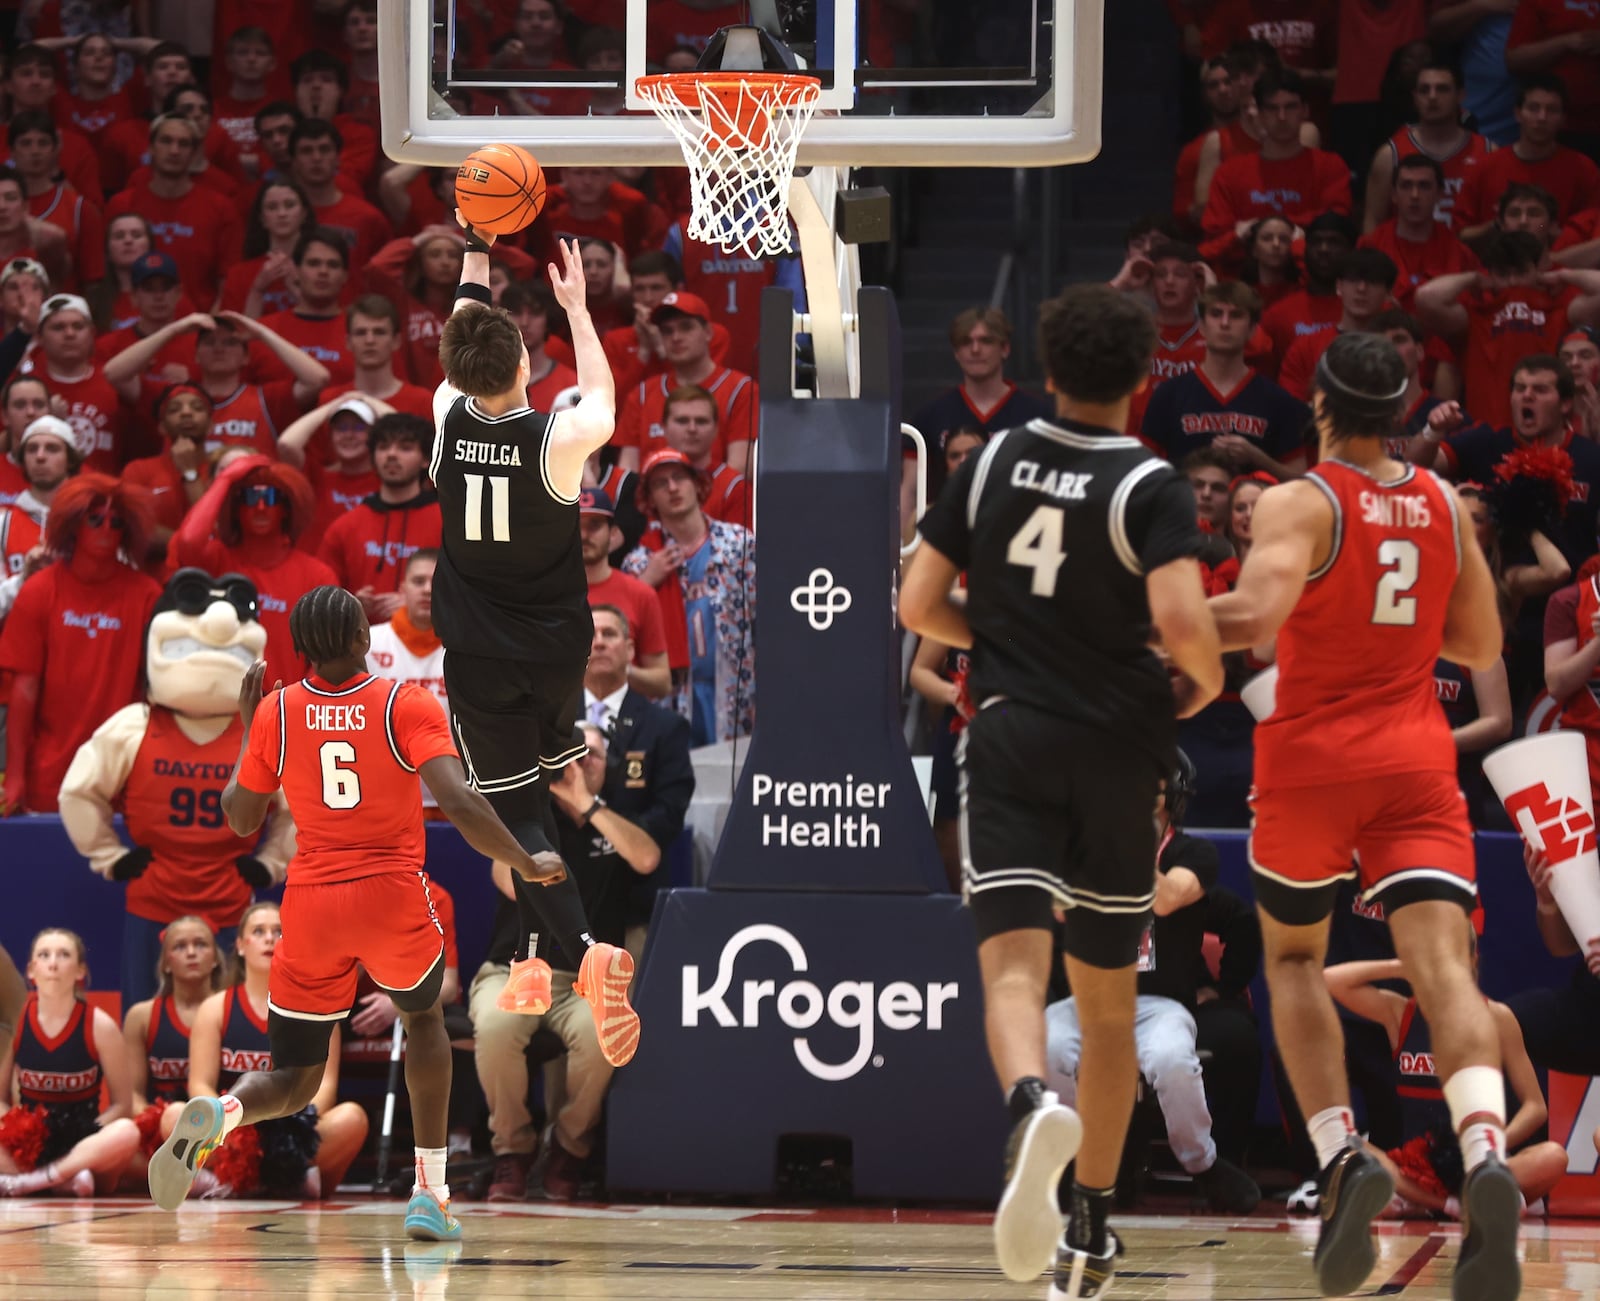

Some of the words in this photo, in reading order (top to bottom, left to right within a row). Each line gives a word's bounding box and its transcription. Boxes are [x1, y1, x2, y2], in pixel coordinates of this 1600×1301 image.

[701, 259, 765, 274] DAYTON
[724, 280, 739, 314] 1
[1181, 411, 1269, 438] DAYTON
[454, 438, 522, 467] SHULGA
[1009, 460, 1094, 500] CLARK
[463, 473, 511, 542] 11
[1358, 490, 1431, 528] SANTOS
[1006, 504, 1068, 598] 4
[1371, 538, 1420, 626] 2
[305, 704, 366, 731] CHEEKS
[152, 759, 236, 780] DAYTO
[318, 740, 361, 810] 6
[168, 787, 223, 829] 99
[751, 773, 892, 808] Premier
[762, 813, 882, 849] Health
[681, 923, 959, 1081] Kroger
